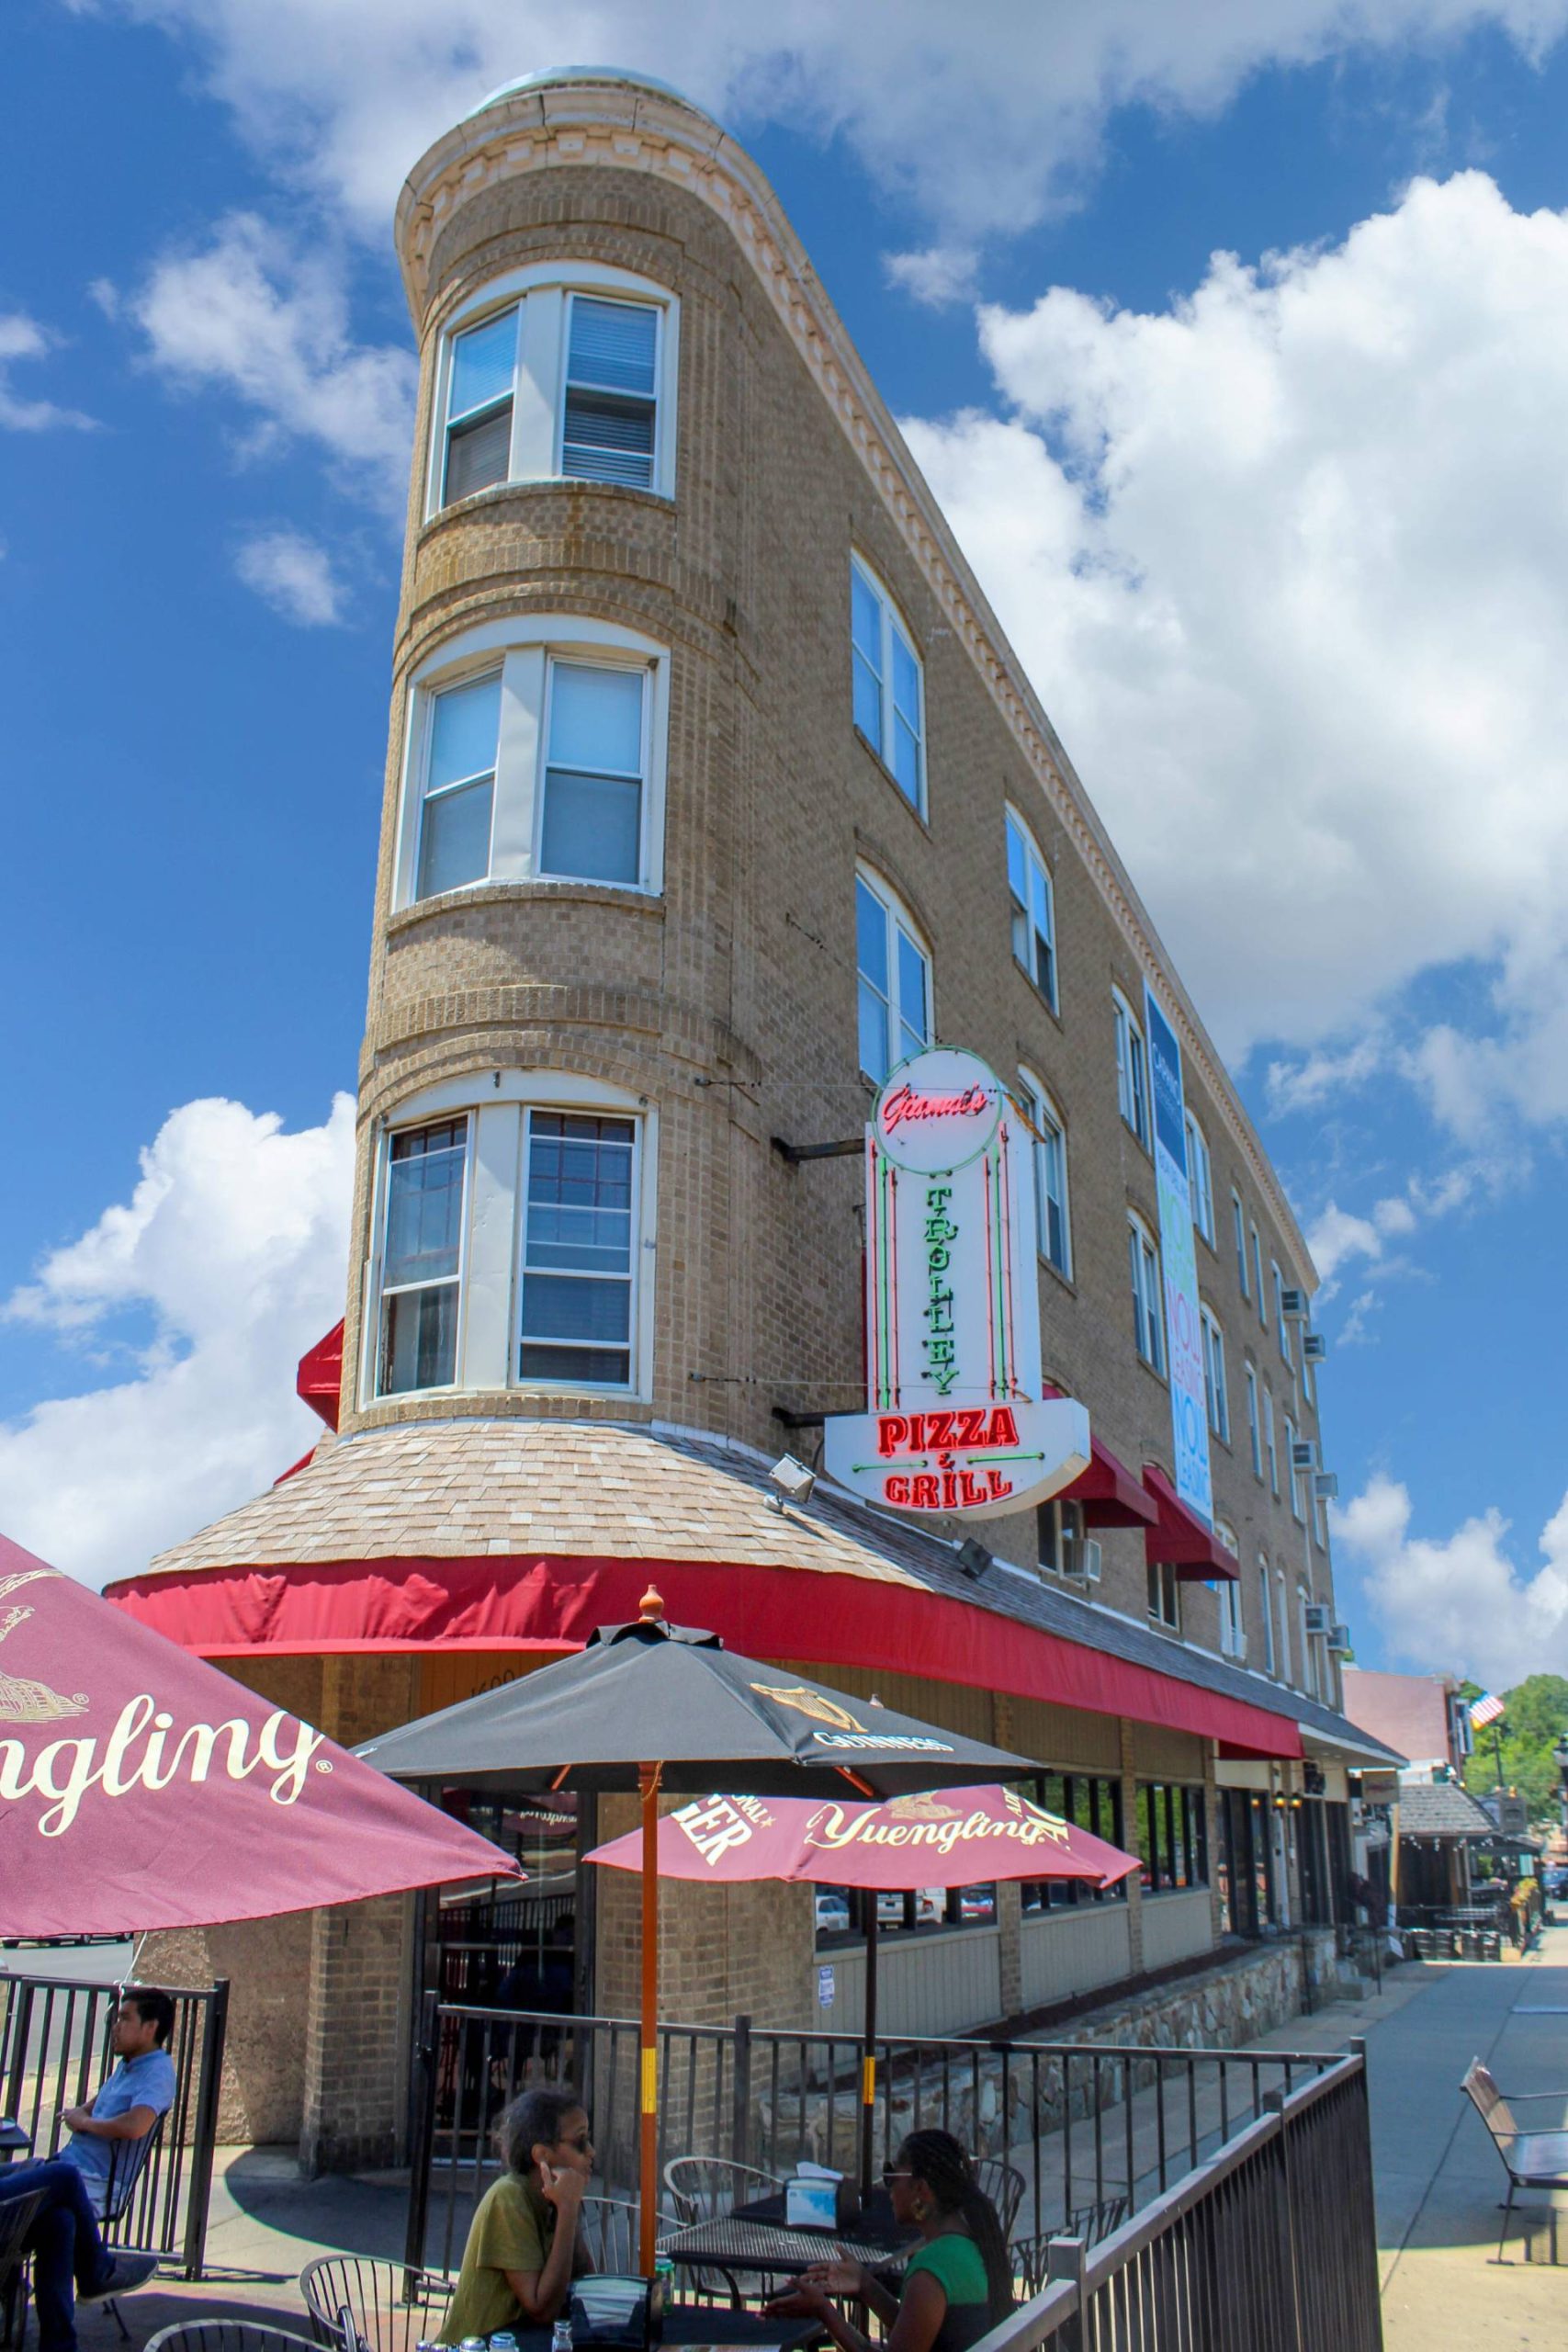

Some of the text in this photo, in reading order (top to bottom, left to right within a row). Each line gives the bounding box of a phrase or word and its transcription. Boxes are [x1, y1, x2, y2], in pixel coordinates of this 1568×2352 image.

[924, 1186, 959, 1396] TROLLEY
[877, 1407, 1020, 1457] PIZZA
[937, 1453, 955, 1471] &
[884, 1470, 1013, 1509] GRILL
[804, 1804, 1039, 1854] Yuengling
